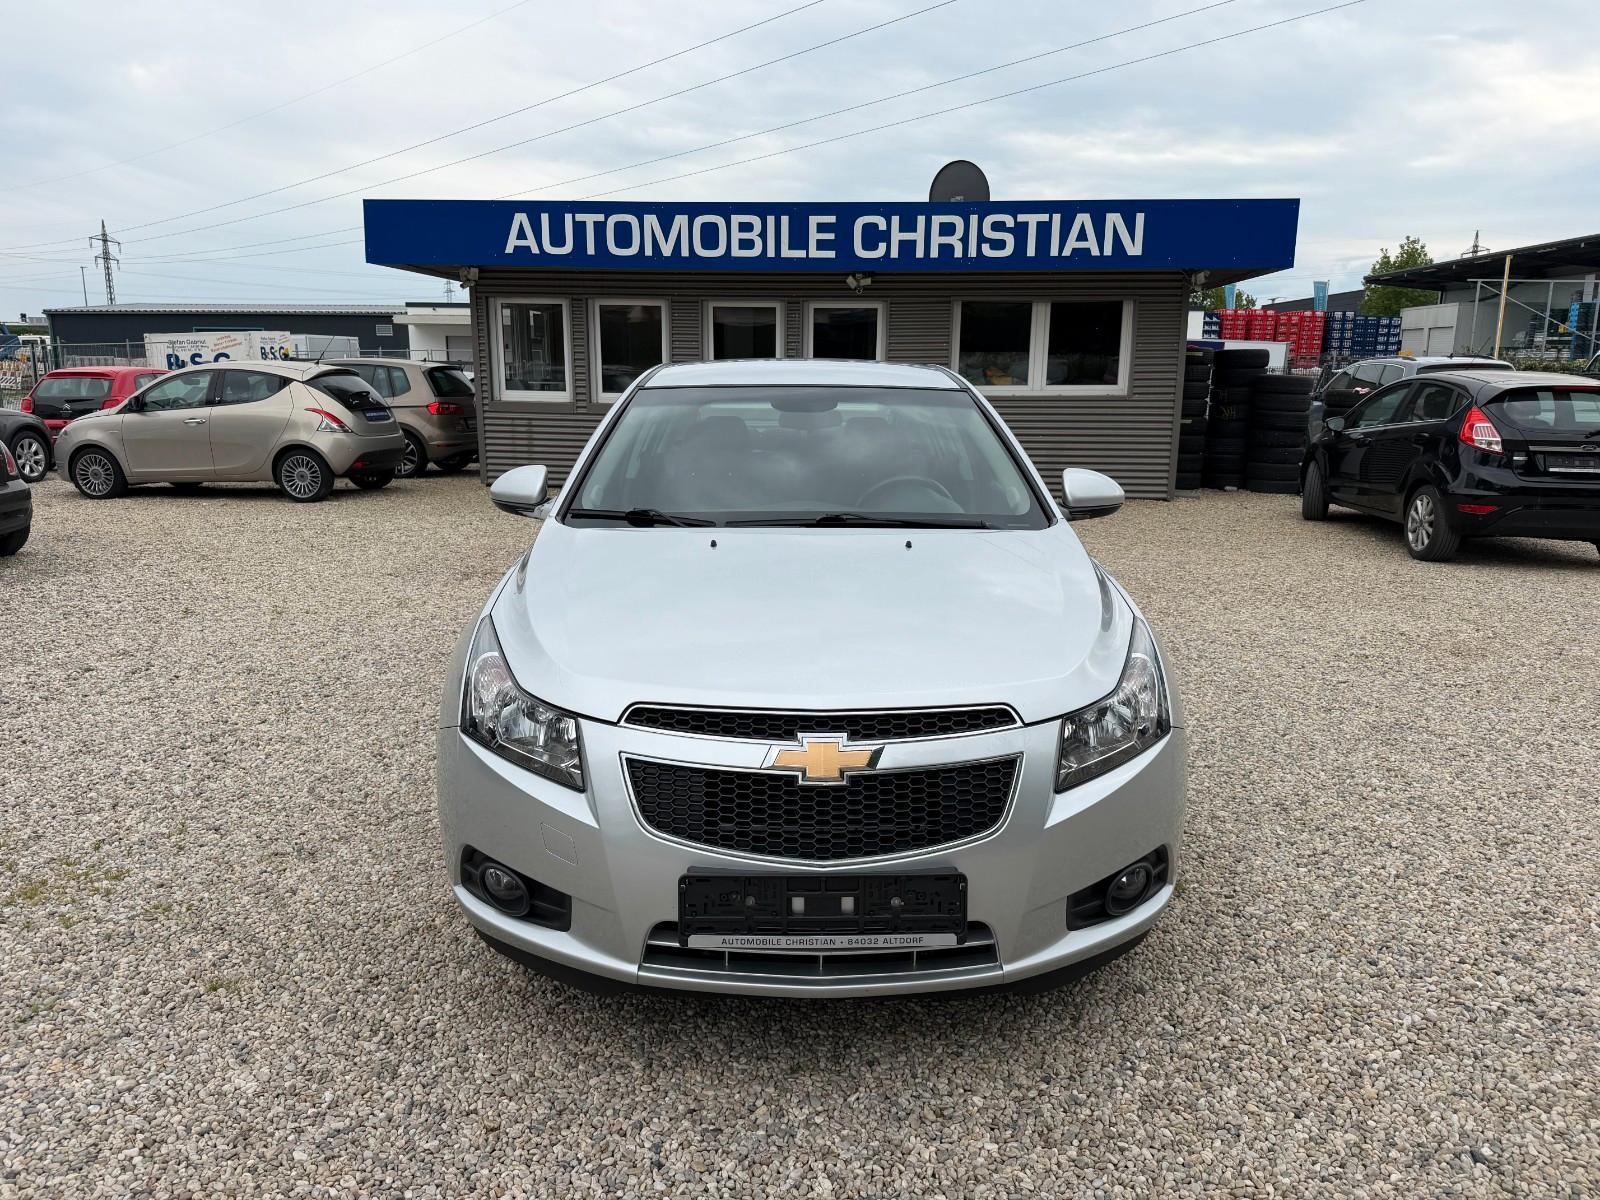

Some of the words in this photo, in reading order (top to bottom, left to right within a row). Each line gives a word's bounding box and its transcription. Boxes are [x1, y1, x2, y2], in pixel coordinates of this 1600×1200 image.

[504, 212, 837, 258] AUTOMOBILE
[853, 212, 1146, 259] CHRISTIAN
[721, 938, 781, 946] AUTOMOBILE
[785, 938, 836, 946] CHRISTIAN
[847, 938, 879, 946] 84032
[882, 936, 924, 945] ALTDORF
